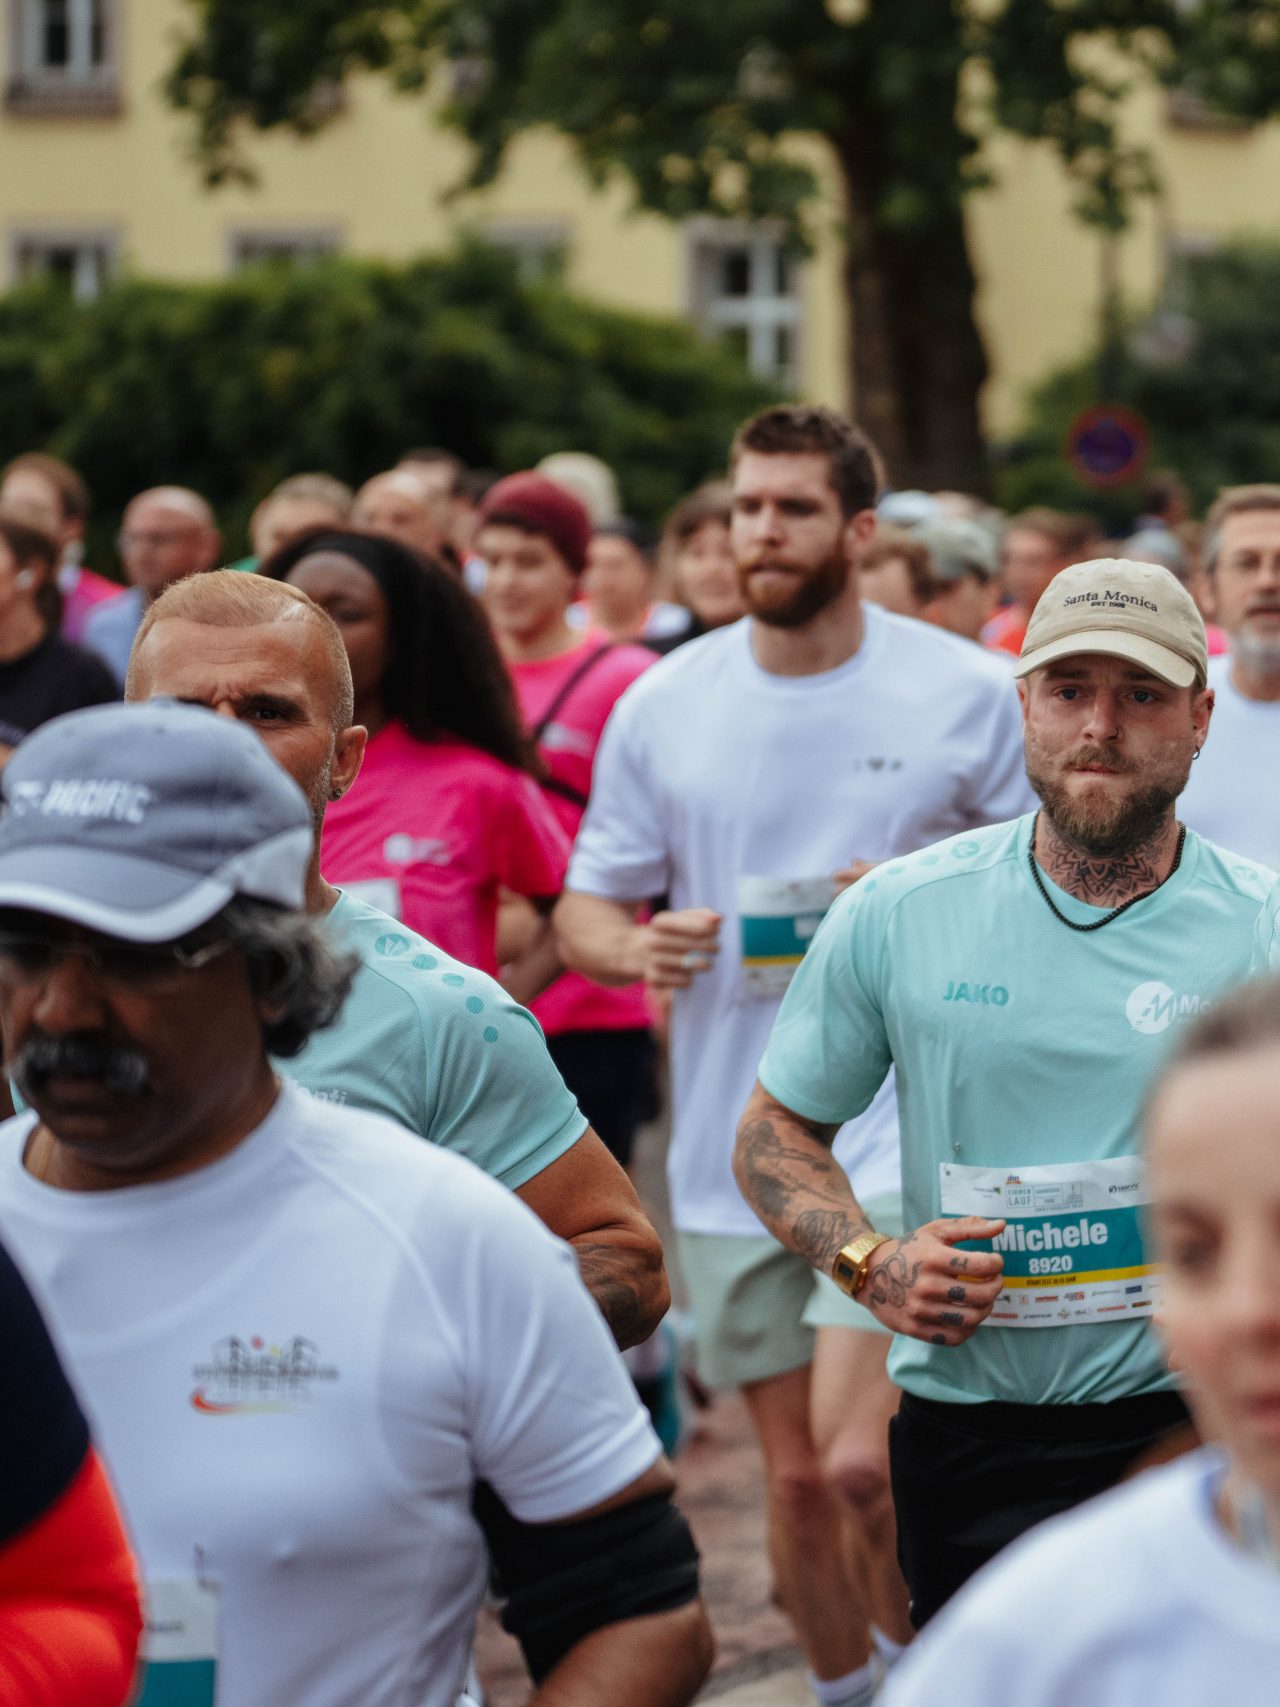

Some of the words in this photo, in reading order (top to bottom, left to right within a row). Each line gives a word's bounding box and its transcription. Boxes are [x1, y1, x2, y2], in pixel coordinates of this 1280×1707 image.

[1063, 591, 1099, 607] Santa
[1104, 590, 1158, 612] Monica
[942, 980, 1009, 1006] JAKO
[1008, 1196, 1031, 1206] LAUF
[992, 1218, 1109, 1252] Michele
[1028, 1255, 1073, 1274] 8920
